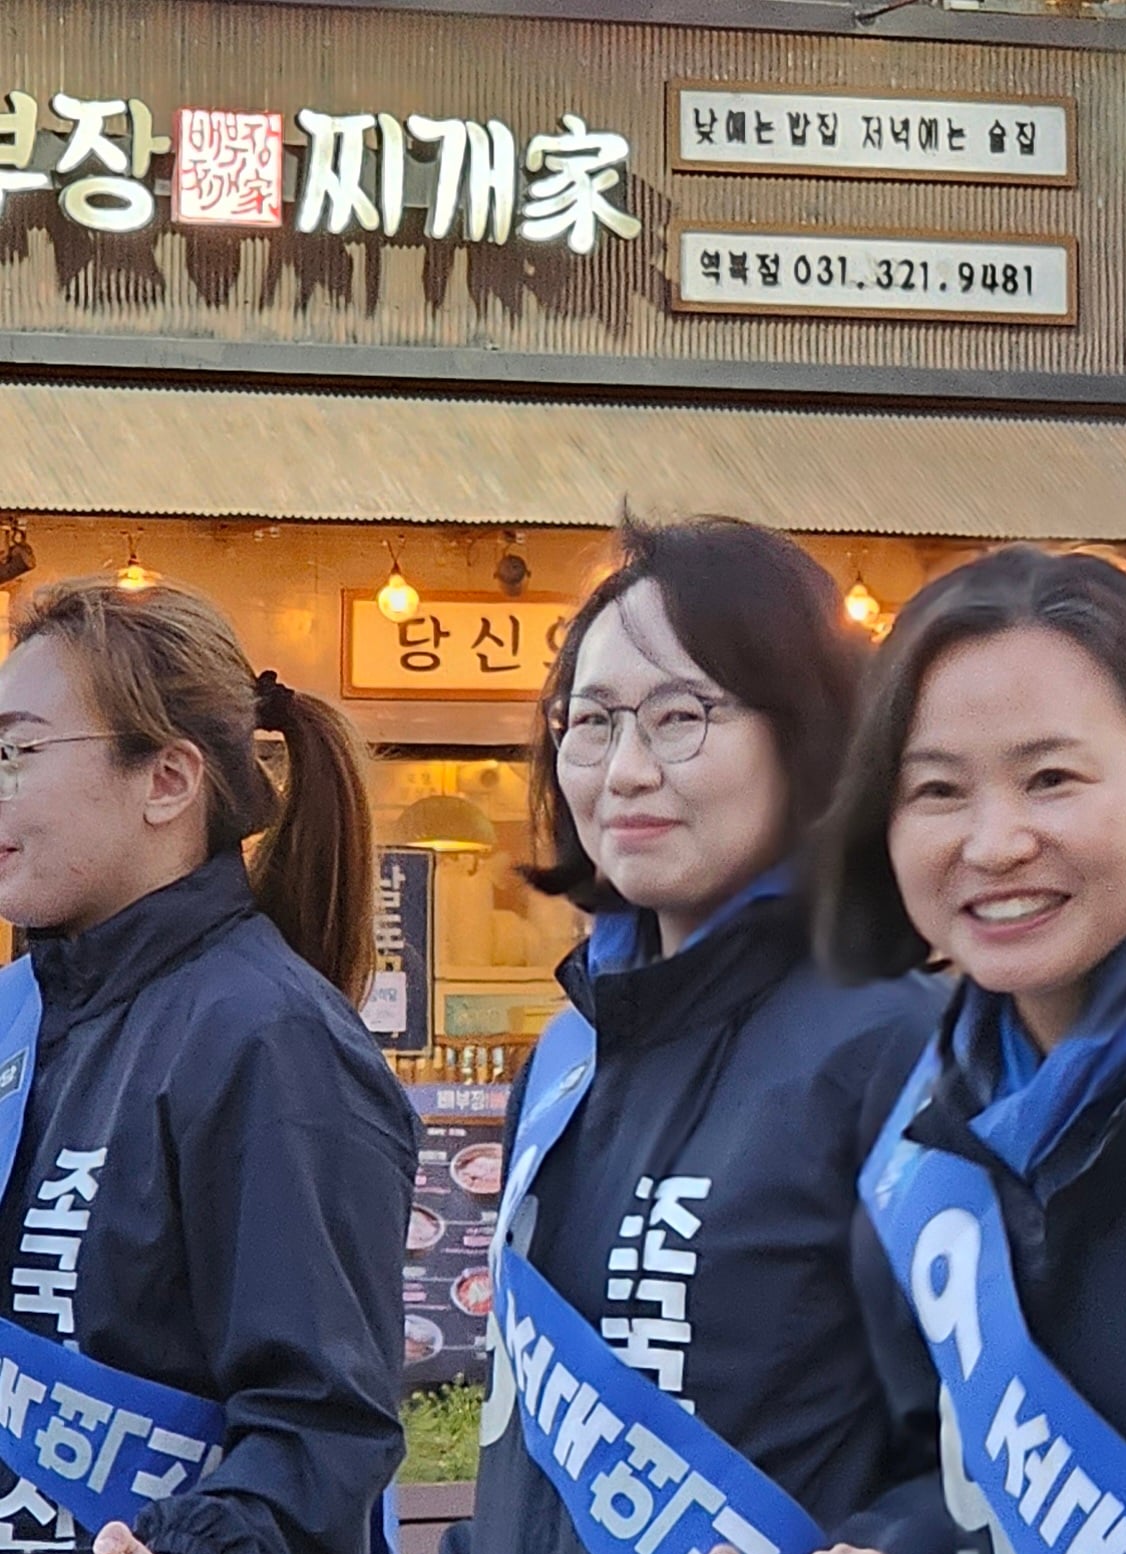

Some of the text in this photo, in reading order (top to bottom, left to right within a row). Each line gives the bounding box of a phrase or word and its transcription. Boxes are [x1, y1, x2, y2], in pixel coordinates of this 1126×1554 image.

[693, 107, 775, 145] 낮에는
[862, 115, 966, 152] 저녁에는
[298, 108, 642, 255] 찌개家
[793, 253, 1034, 296] 031.321.9481
[911, 1207, 983, 1382] 9
